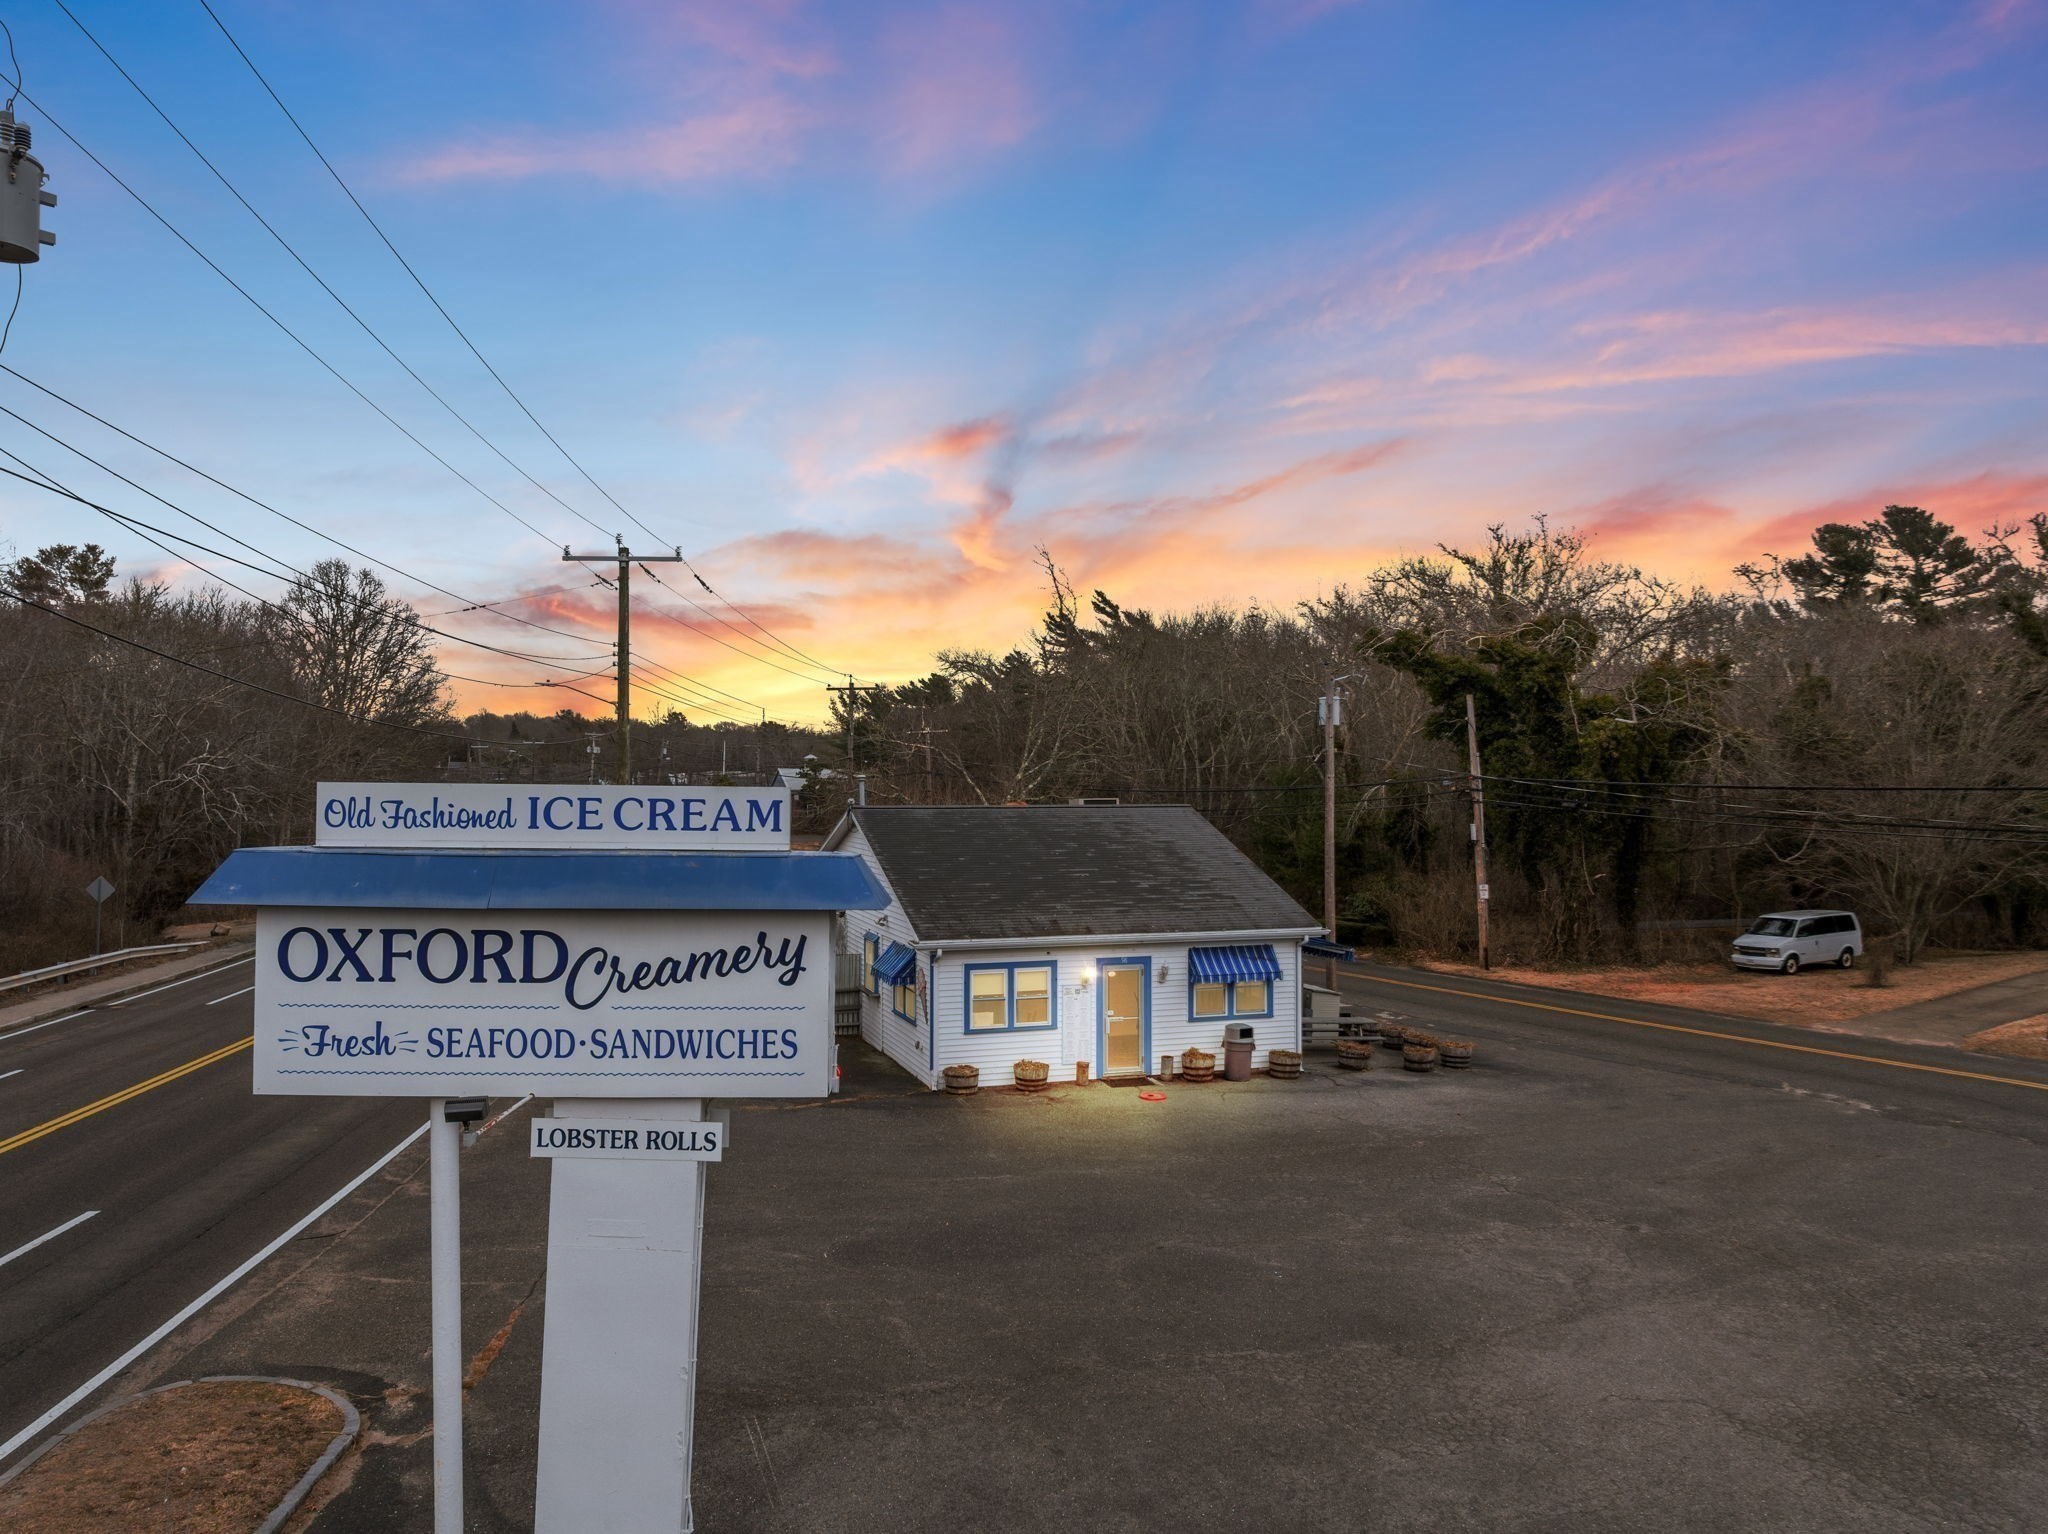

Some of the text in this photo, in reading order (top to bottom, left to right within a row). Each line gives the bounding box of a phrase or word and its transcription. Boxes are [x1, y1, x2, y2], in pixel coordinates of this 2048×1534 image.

[325, 797, 781, 833] Old Fashioned ICE CREAM
[277, 926, 808, 1011] OXFORD Creamery
[301, 1021, 397, 1057] Fresh
[536, 1127, 717, 1153] LOBSTER ROLLS
